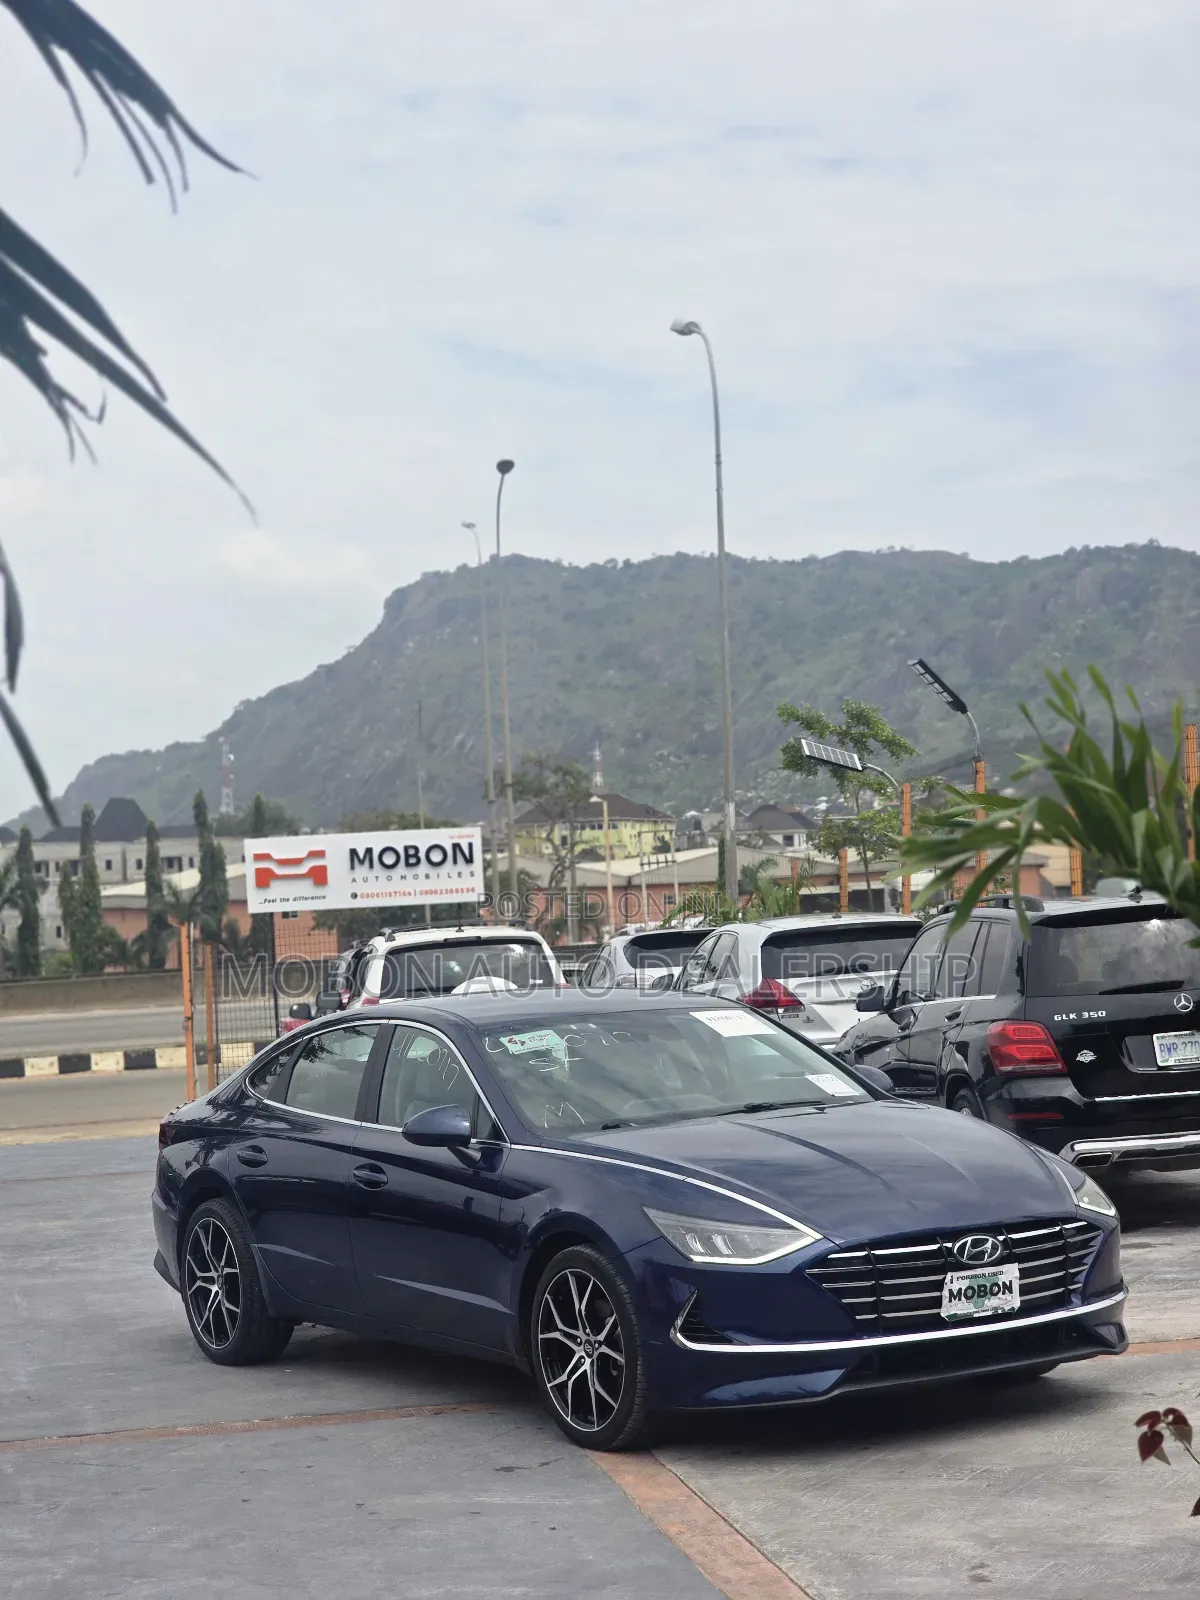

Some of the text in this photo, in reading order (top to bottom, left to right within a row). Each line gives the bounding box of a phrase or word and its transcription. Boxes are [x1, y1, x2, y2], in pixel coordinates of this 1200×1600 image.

[349, 841, 475, 871] MOBON
[351, 871, 475, 884] AUTOMOBILES
[292, 894, 327, 902] difference
[1054, 1010, 1107, 1021] GLK 350
[948, 1280, 1014, 1303] MOBON
